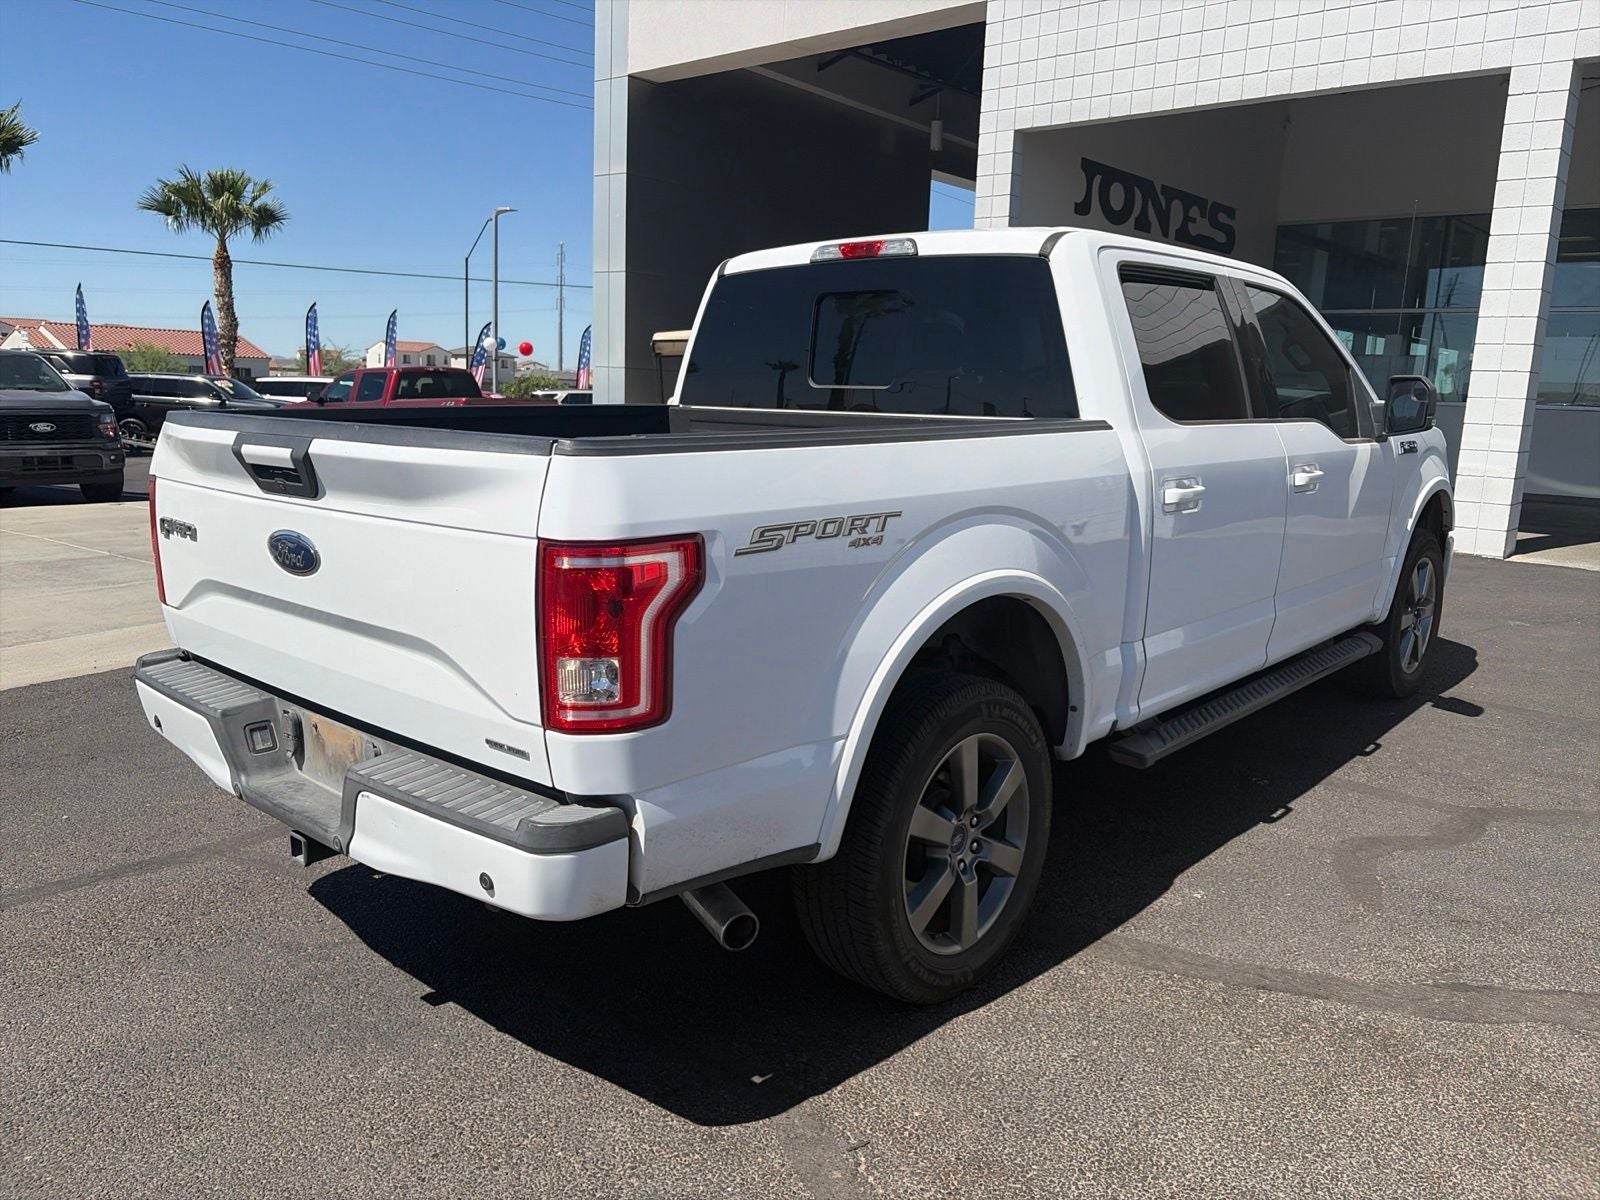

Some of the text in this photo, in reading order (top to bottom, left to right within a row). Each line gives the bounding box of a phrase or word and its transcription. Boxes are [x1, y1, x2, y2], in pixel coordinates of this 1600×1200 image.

[1074, 157, 1237, 255] JONES
[276, 540, 306, 567] Ford
[734, 511, 903, 557] SPORT
